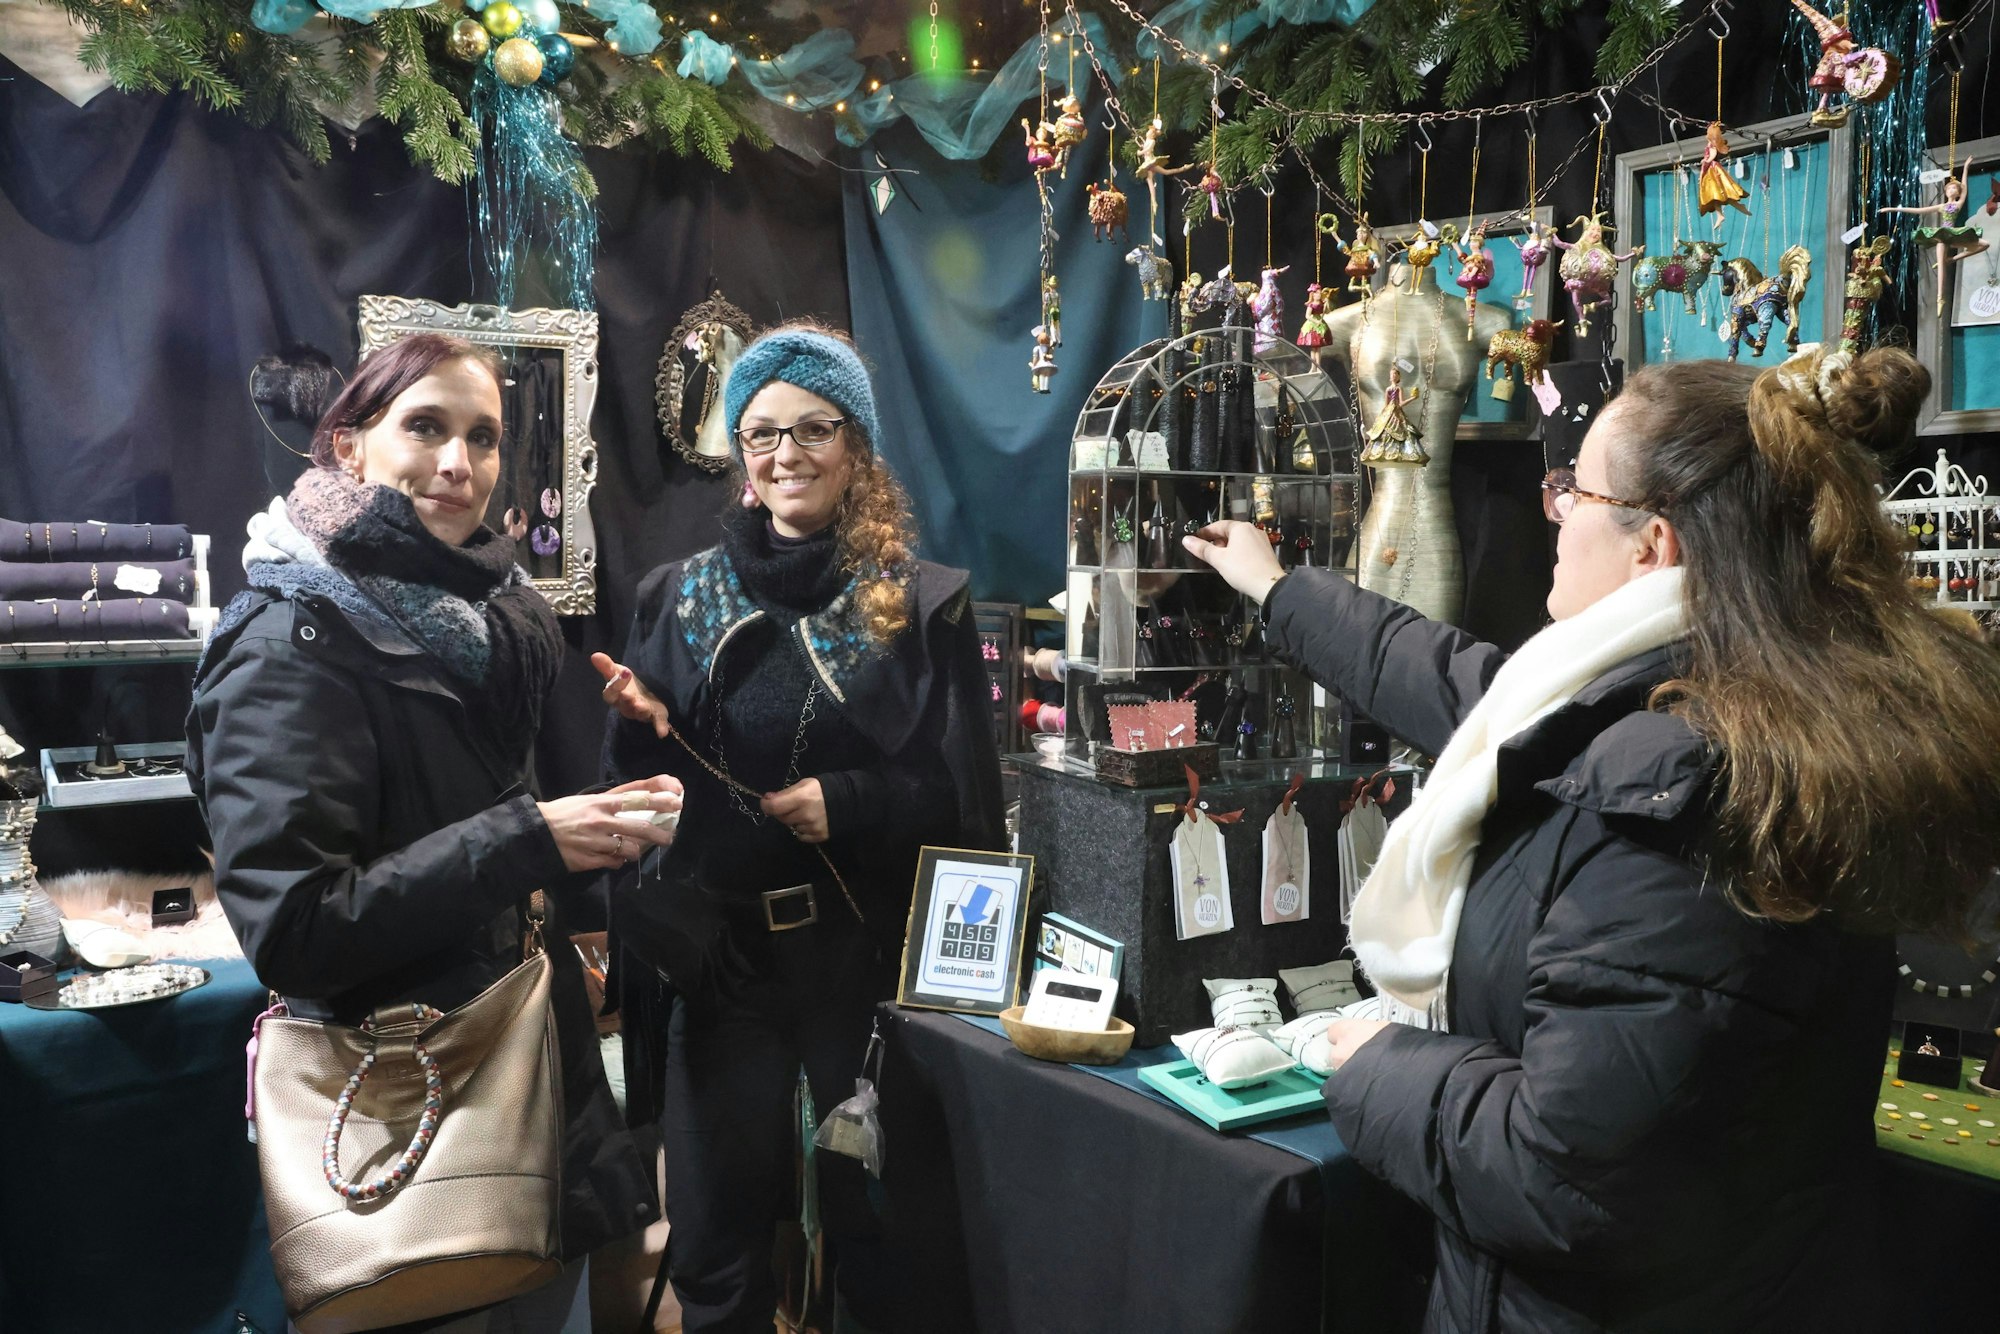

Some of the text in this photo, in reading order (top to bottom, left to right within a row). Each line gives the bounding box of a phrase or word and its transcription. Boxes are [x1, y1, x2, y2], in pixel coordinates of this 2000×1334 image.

[1279, 887, 1297, 903] VON
[1199, 898, 1219, 913] VON
[948, 925, 992, 940] 4 5 6
[946, 943, 990, 959] 7 8 9
[933, 964, 995, 979] electronic cash
